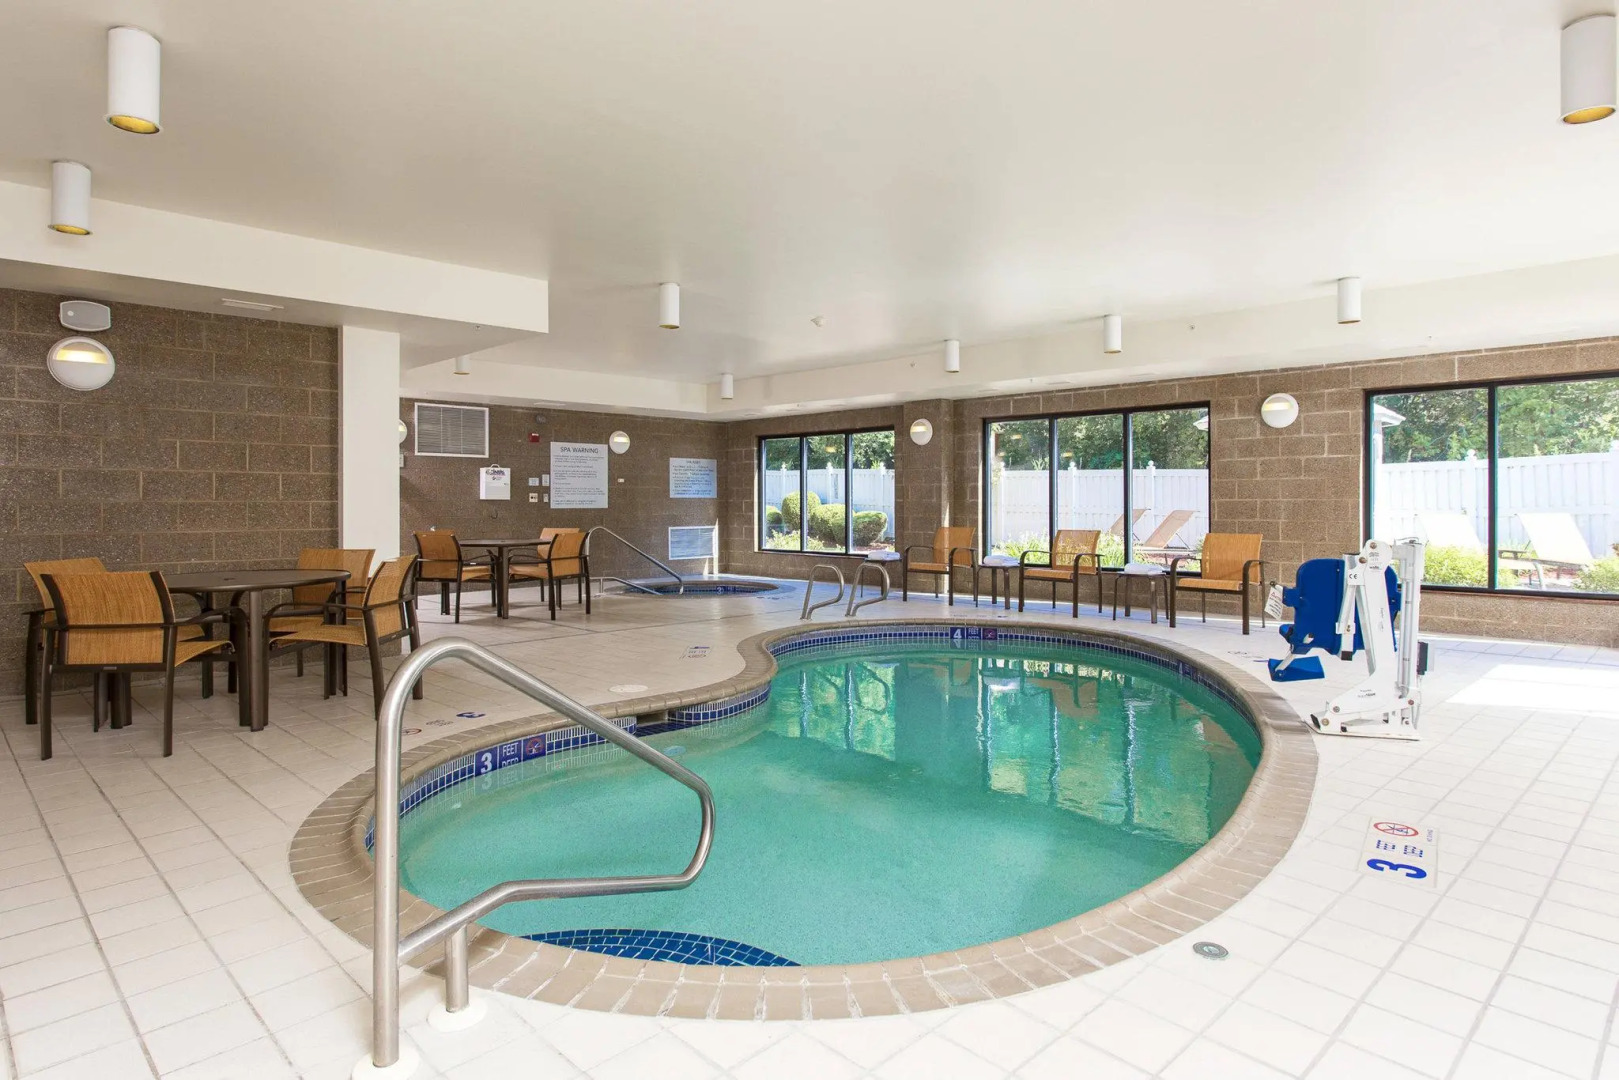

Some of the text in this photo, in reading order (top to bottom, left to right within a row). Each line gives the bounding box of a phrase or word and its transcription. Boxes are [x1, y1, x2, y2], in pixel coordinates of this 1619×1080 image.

[953, 628, 962, 639] 4
[502, 742, 519, 757] FEET
[480, 752, 493, 774] 3
[1366, 858, 1427, 879] 3
